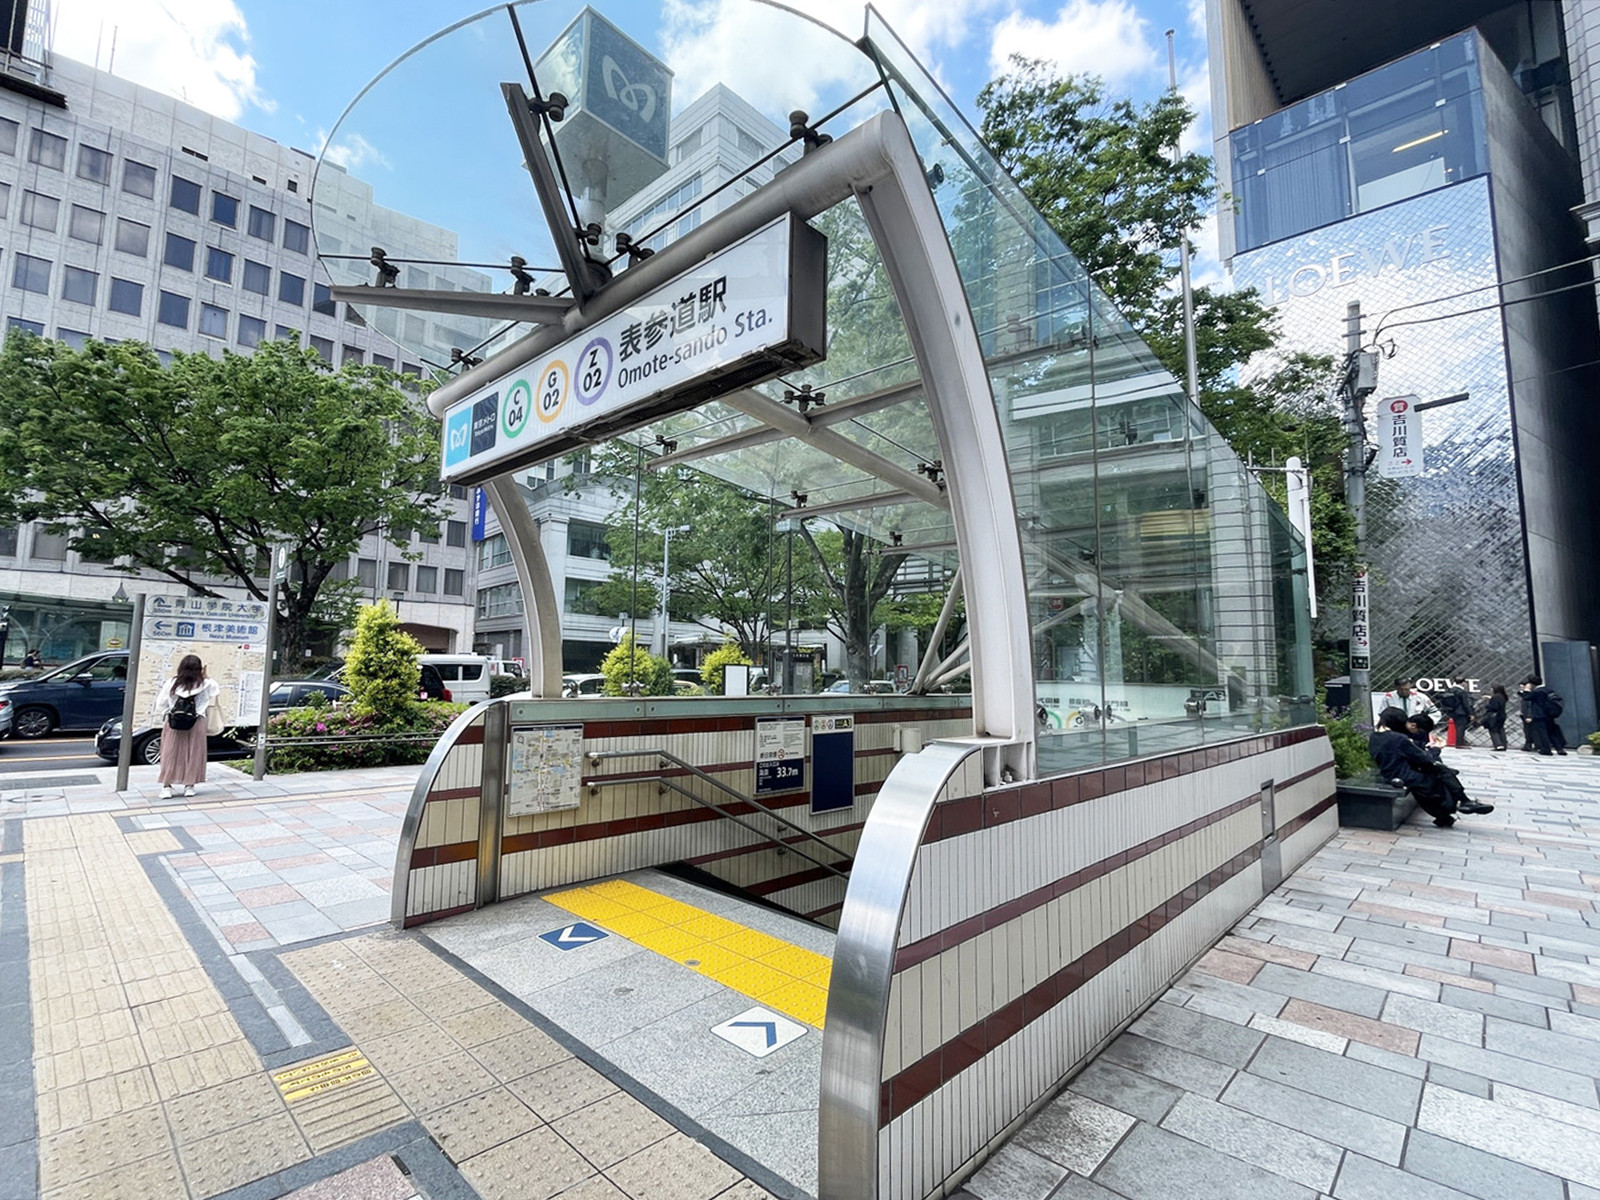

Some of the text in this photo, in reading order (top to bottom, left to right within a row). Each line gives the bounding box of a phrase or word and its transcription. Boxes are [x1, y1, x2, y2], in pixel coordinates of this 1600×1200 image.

[1265, 225, 1450, 306] LOEWE
[619, 275, 728, 364] 表参道駅
[588, 350, 598, 366] Z
[618, 309, 773, 389] Omote-sando Sta.
[548, 371, 557, 388] G
[583, 367, 602, 393] 02
[513, 389, 520, 405] C
[543, 388, 559, 410] 02
[508, 406, 523, 427] 04
[201, 623, 258, 635] 根津美術館
[1204, 690, 1225, 700] A3
[776, 767, 798, 778] 33.7m
